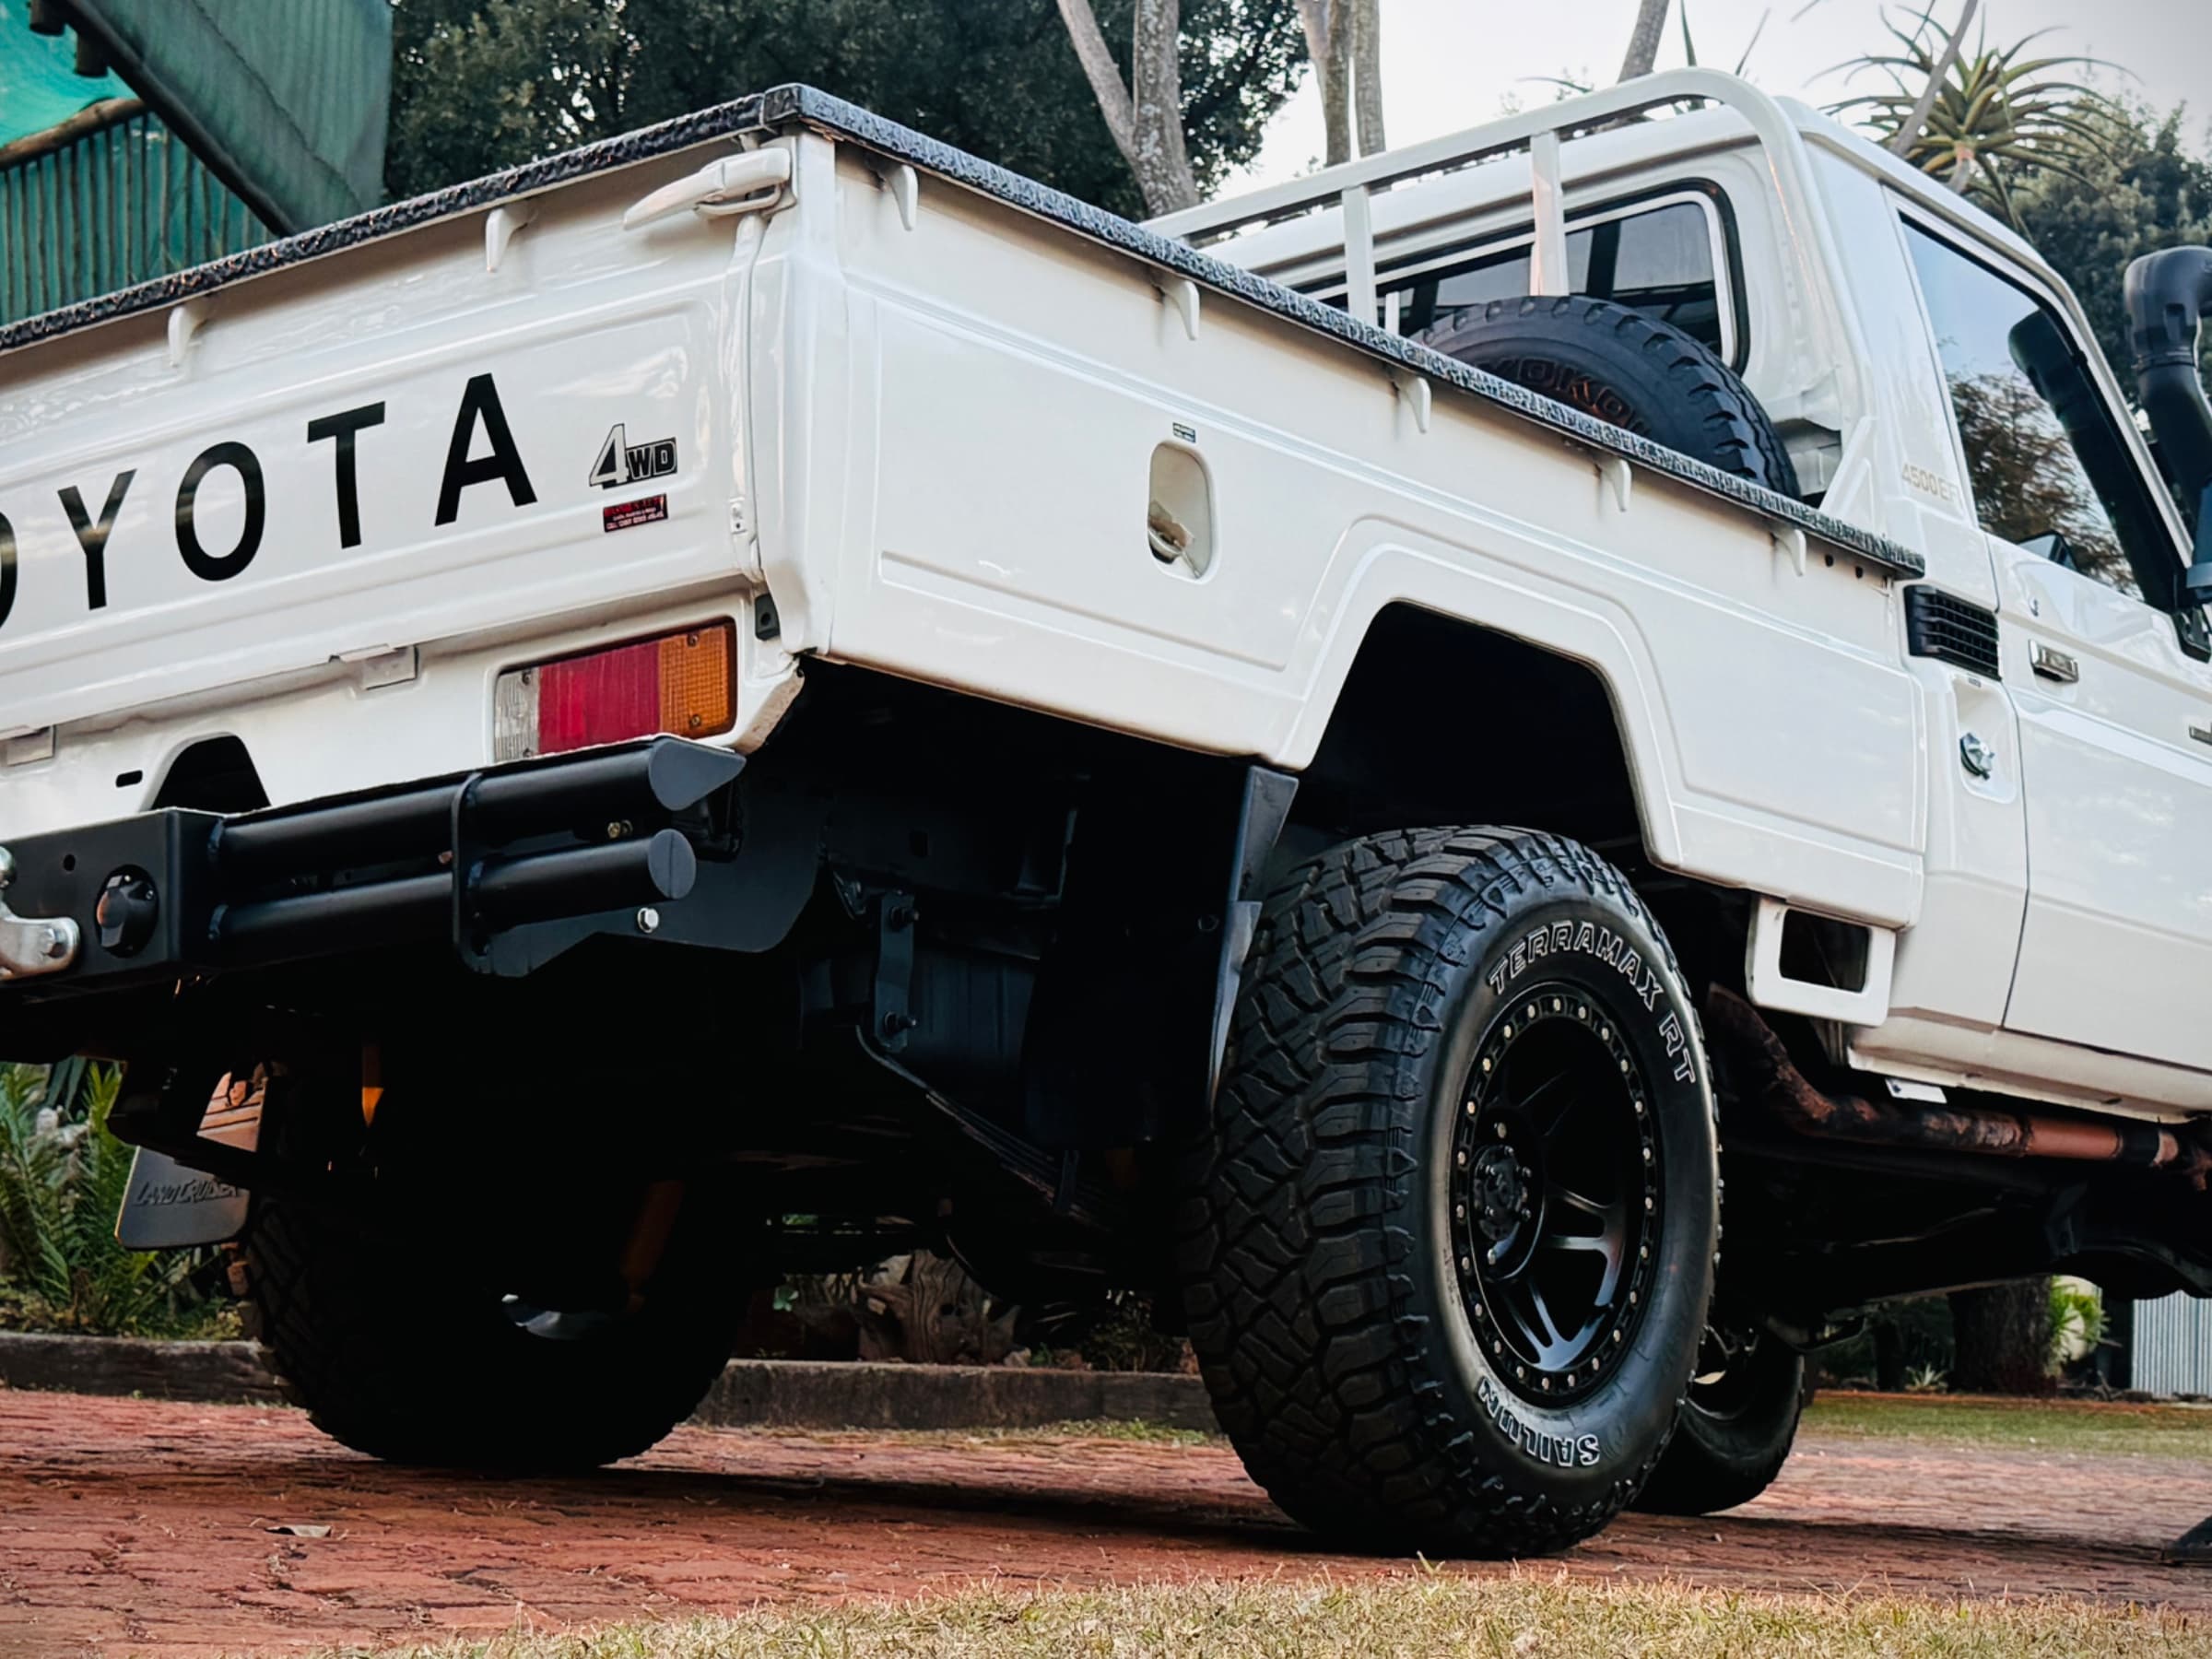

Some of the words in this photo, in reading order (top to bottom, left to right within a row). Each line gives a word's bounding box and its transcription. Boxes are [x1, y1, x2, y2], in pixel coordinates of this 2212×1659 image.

[0, 372, 537, 629] YOTA
[589, 423, 677, 488] 4WD
[1488, 920, 1664, 1012] TERRAMAX
[1659, 1010, 1696, 1083] RT
[1477, 1376, 1600, 1467] SAILUN
